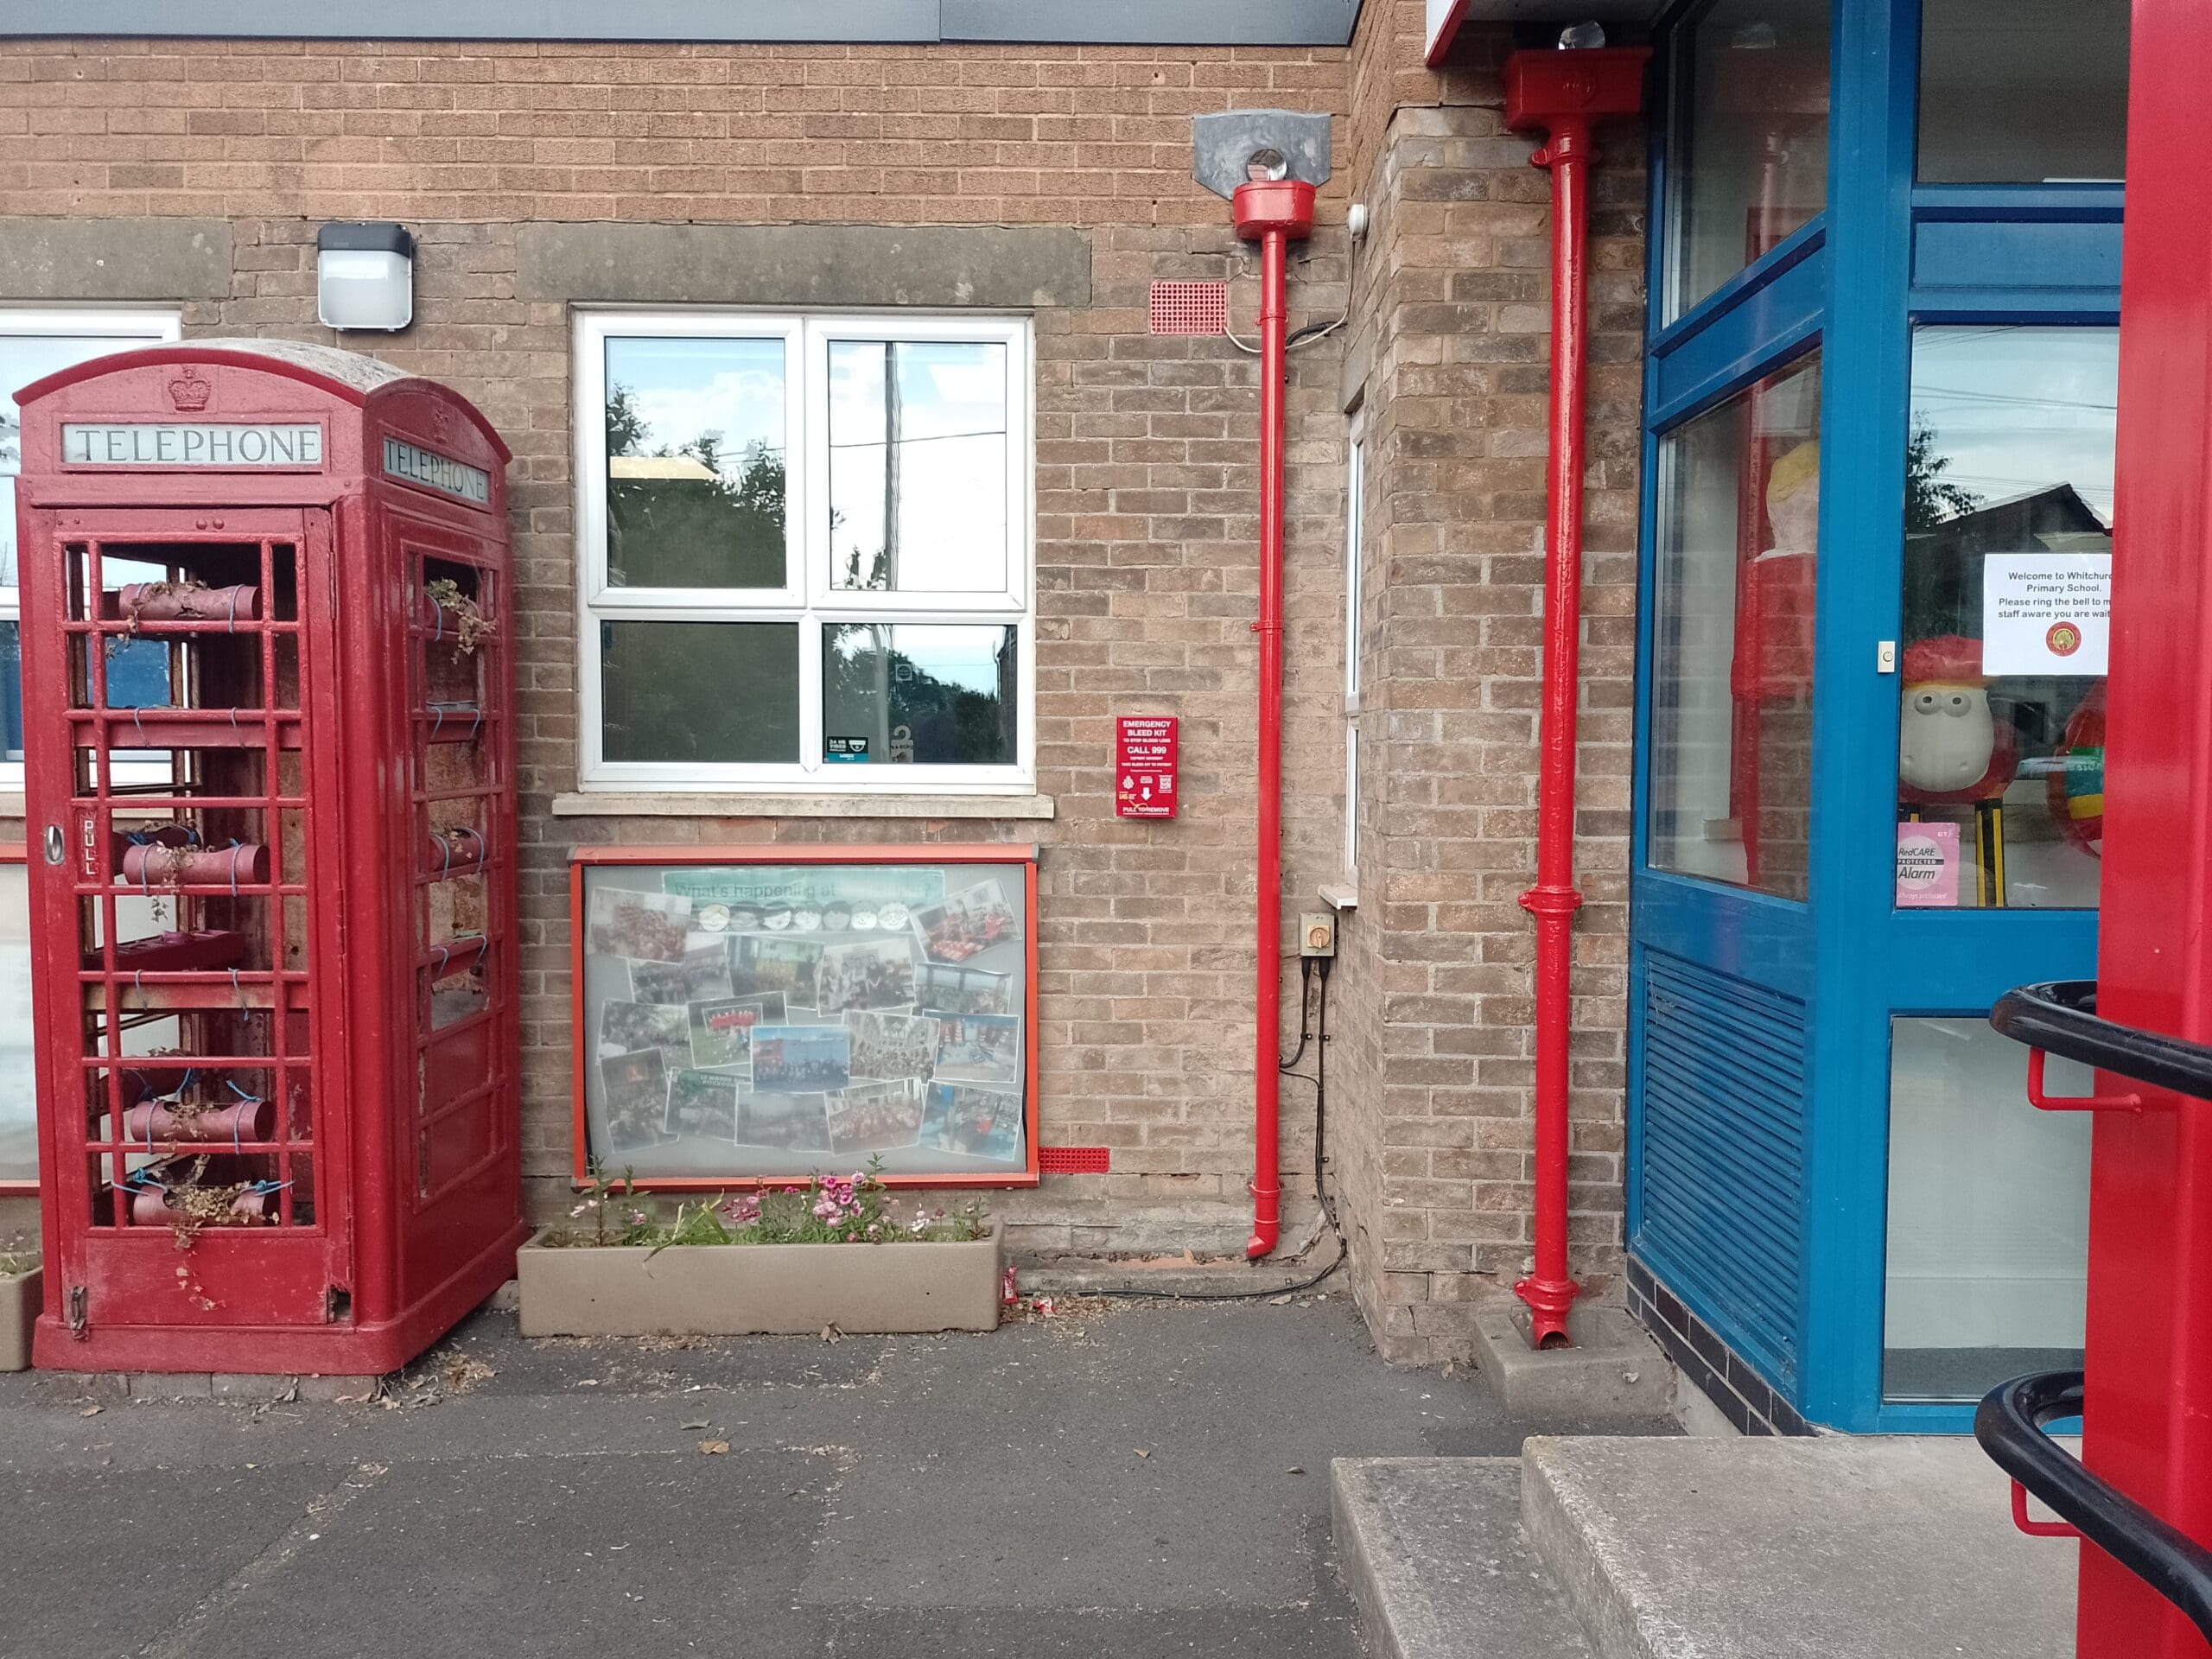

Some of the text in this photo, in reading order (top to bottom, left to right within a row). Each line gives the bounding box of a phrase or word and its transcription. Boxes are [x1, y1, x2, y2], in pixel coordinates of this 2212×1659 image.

[75, 430, 319, 462] TELEPHONE
[385, 439, 485, 500] TELEPHONE
[2008, 571, 2112, 581] Welcome to Whitchurc
[2026, 583, 2102, 594] Primary School.
[1999, 597, 2031, 606] Please
[2032, 597, 2052, 607] ring
[2055, 597, 2070, 606] the
[2072, 597, 2090, 606] bell
[2092, 597, 2101, 606] to
[1998, 609, 2019, 618] staff
[2054, 610, 2072, 620] you
[2091, 609, 2110, 618] wait
[1122, 720, 1172, 728] EMERGENCY
[1127, 746, 1167, 754] CALL 999
[84, 820, 97, 875] PULL
[1898, 848, 1936, 856] RedCARE
[1898, 866, 1936, 880] Alarm
[674, 883, 728, 899] What's
[734, 883, 816, 899] happening
